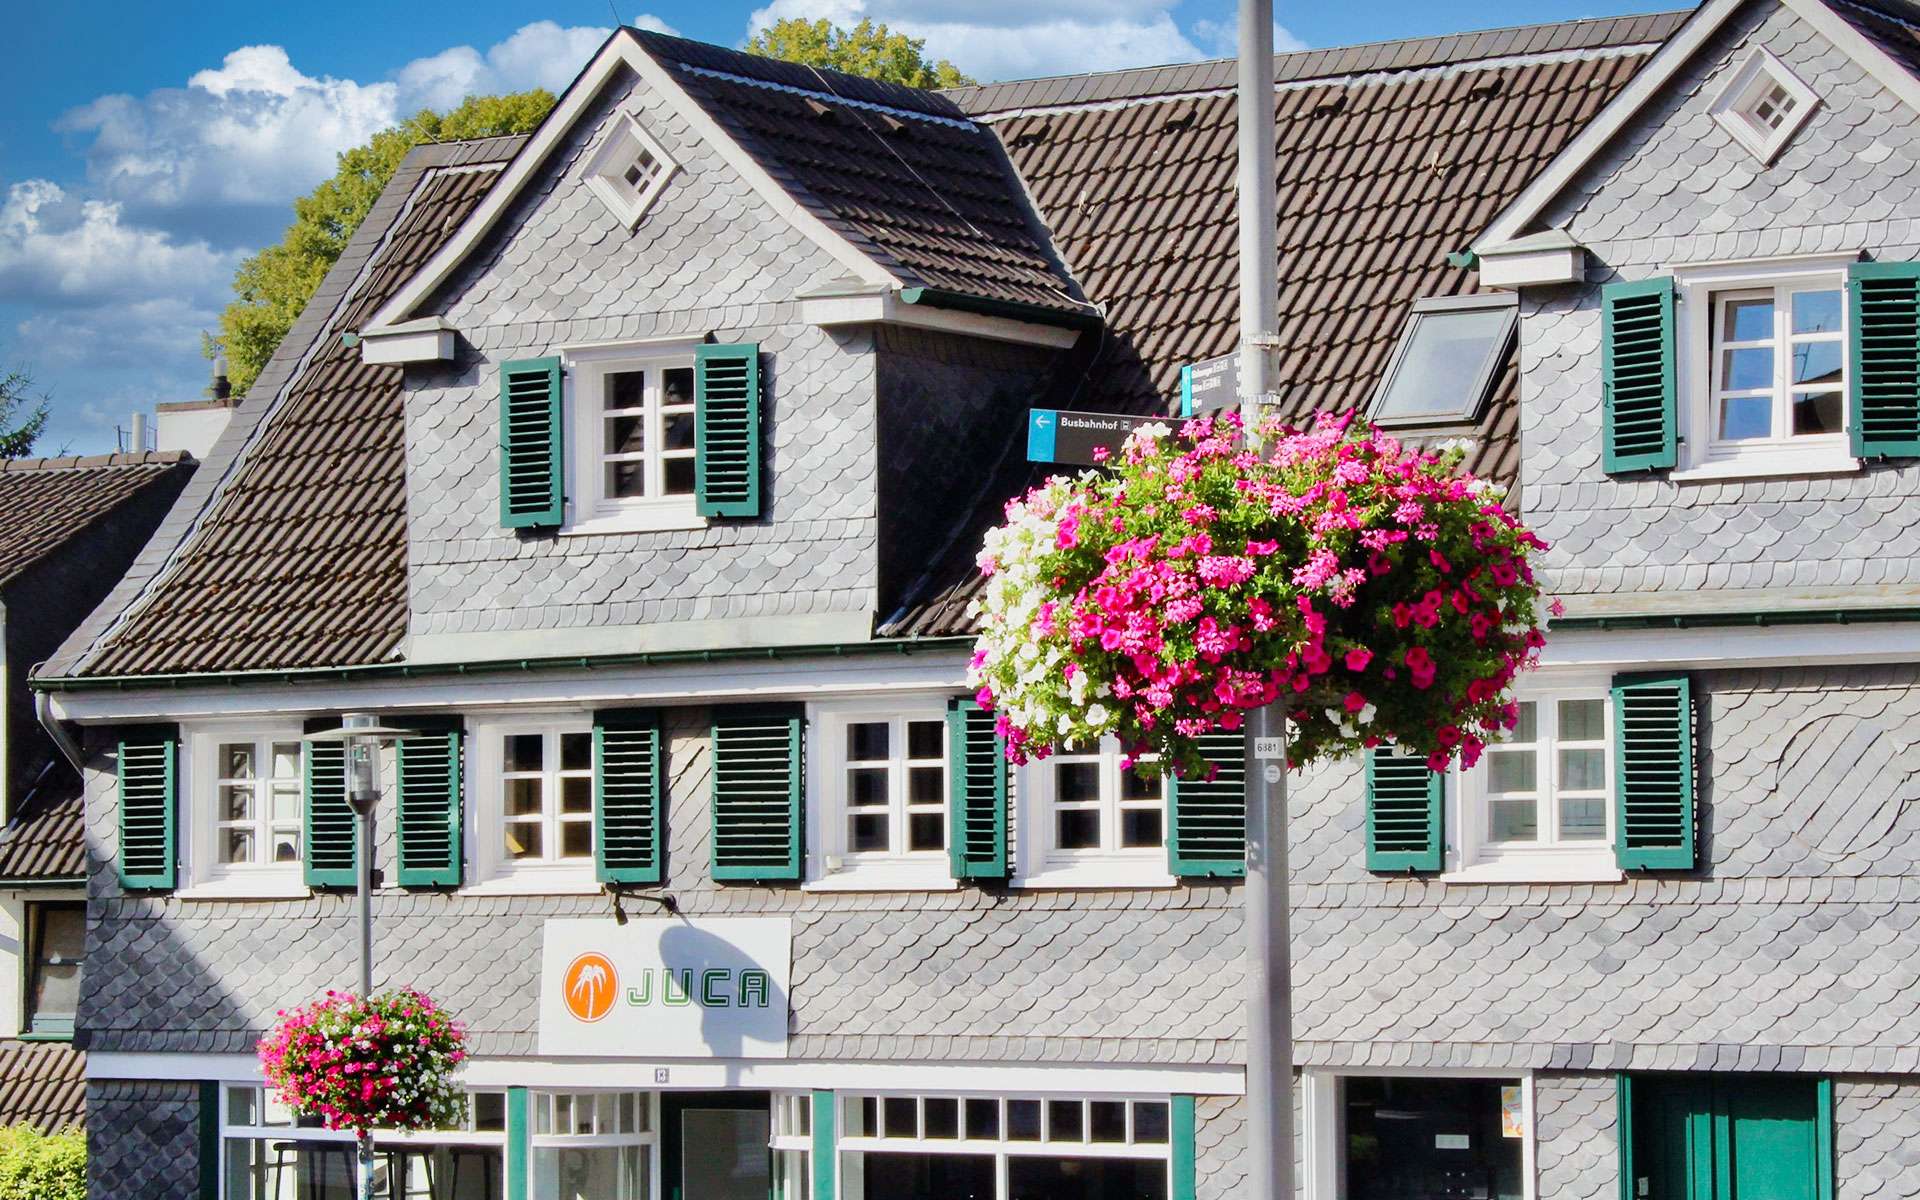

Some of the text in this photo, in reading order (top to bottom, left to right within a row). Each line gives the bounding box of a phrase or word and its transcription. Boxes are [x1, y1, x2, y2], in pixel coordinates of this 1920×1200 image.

[1061, 417, 1118, 430] Busbahnhof
[1257, 743, 1277, 752] 6381
[627, 968, 770, 1007] JUCA
